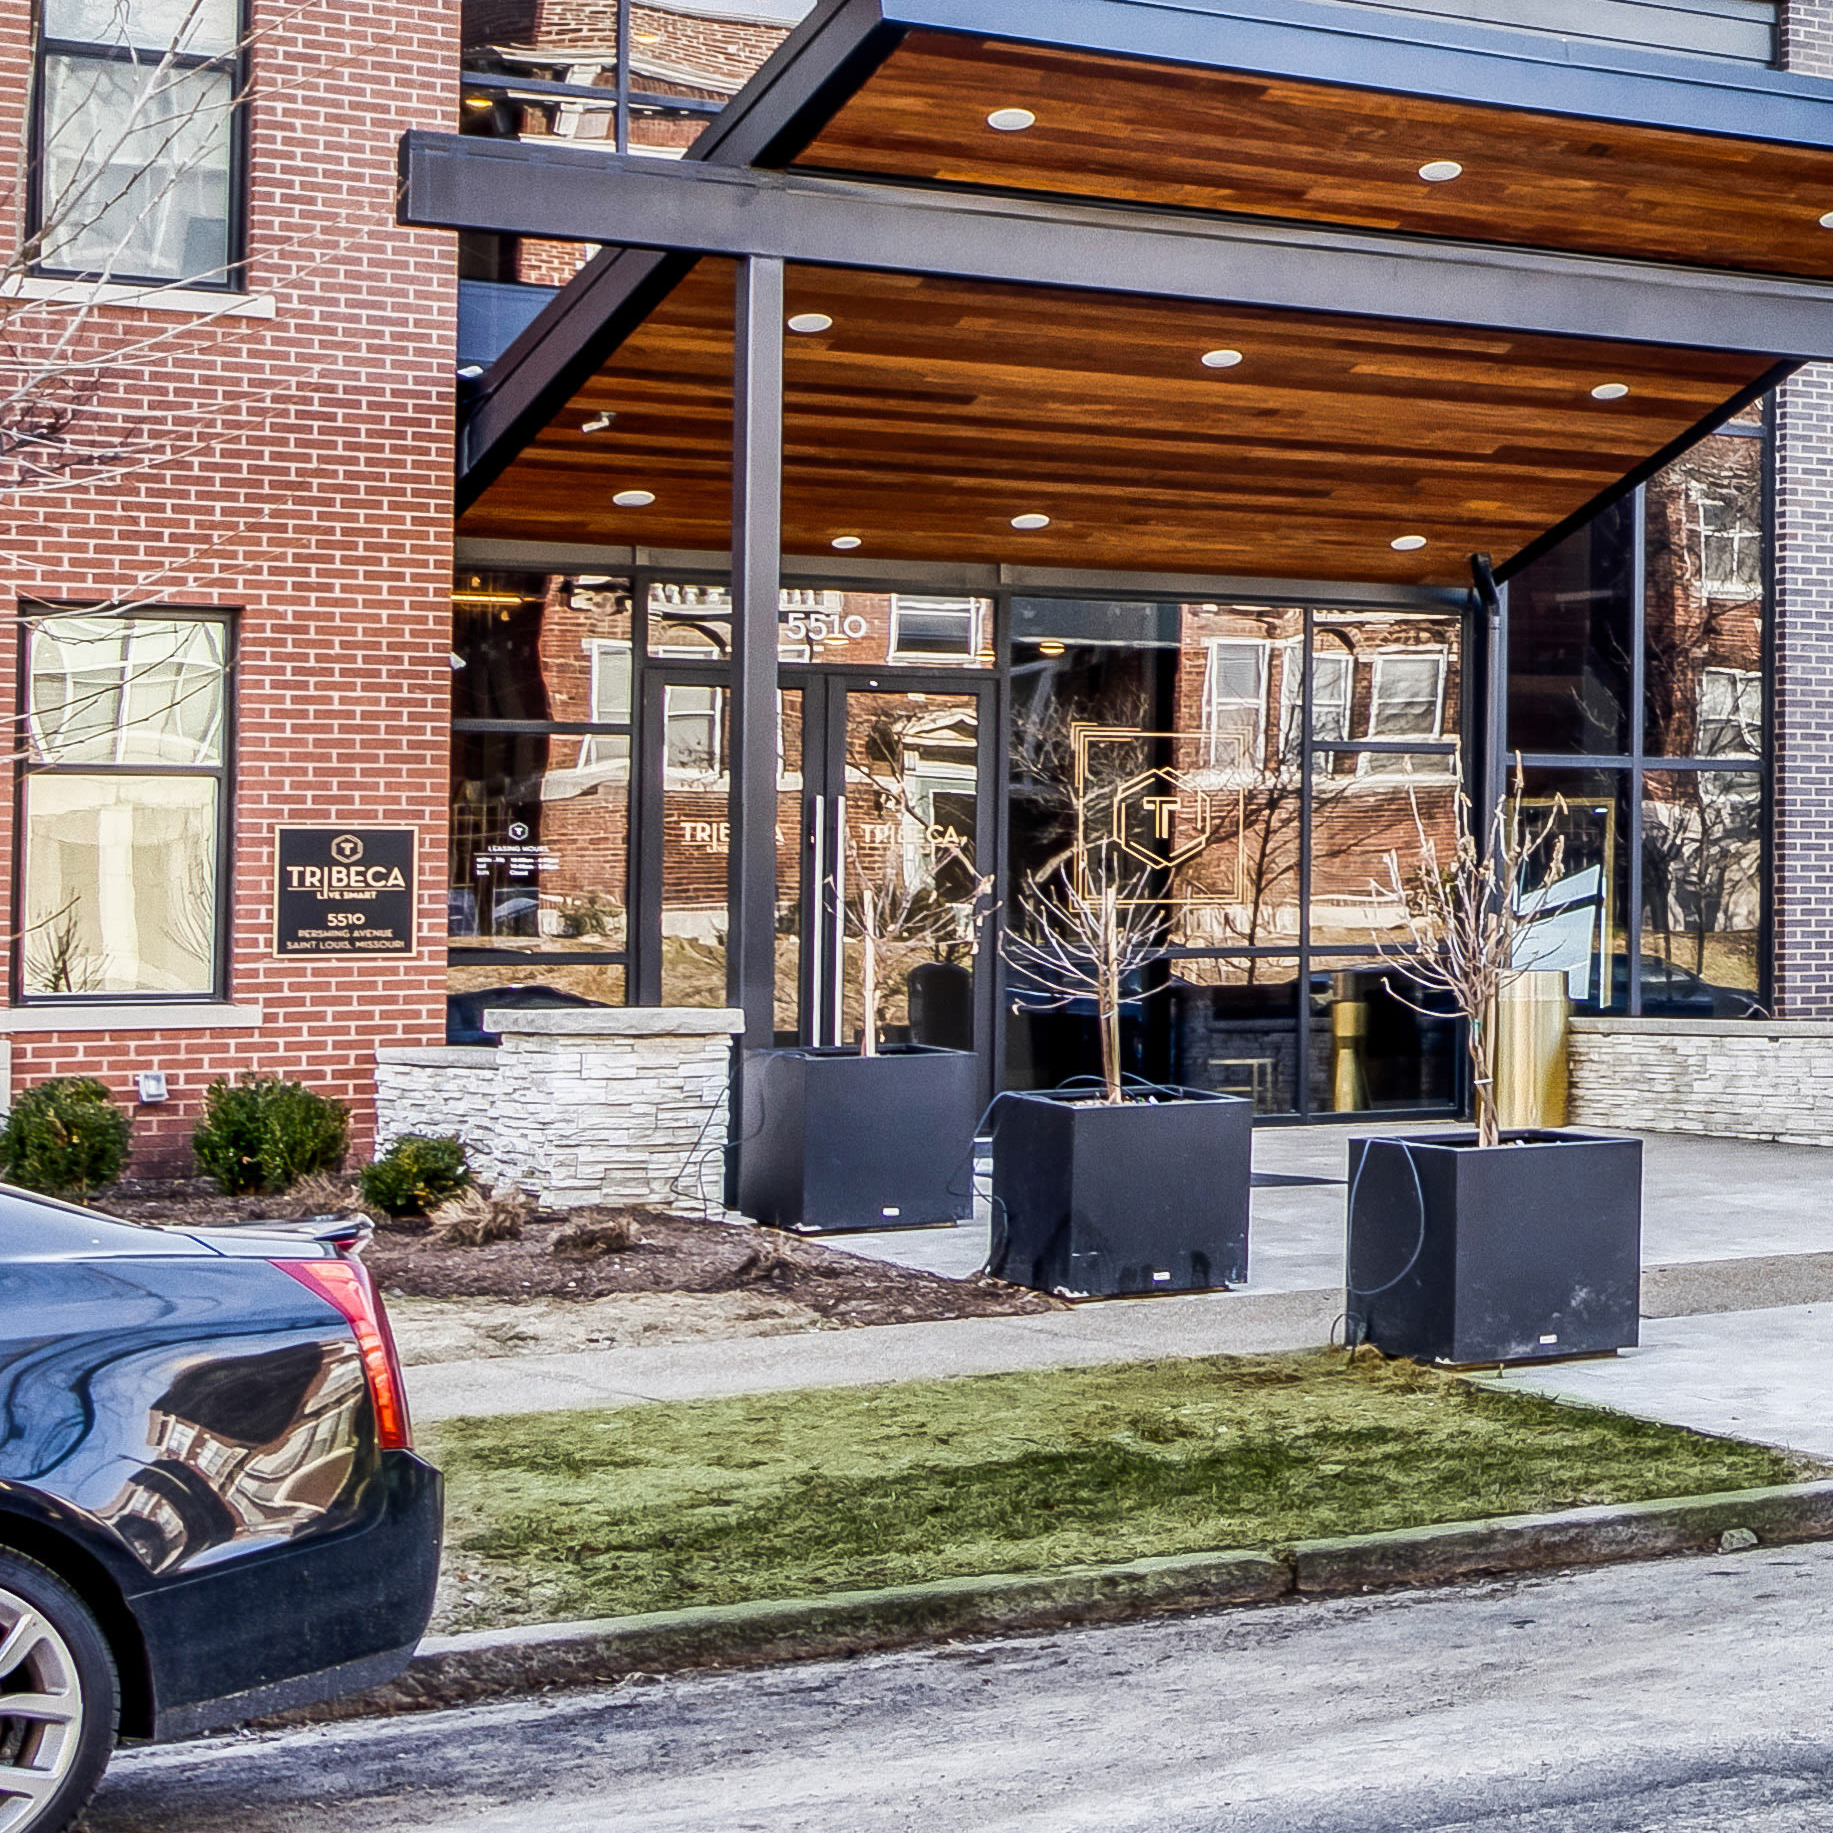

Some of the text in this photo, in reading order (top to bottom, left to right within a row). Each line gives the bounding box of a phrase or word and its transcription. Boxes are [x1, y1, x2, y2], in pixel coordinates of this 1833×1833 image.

[785, 612, 867, 640] 5510
[286, 866, 406, 890] TRIBECA
[316, 891, 378, 899] LIVE SMART
[327, 913, 366, 927] 5510
[298, 929, 393, 938] PERSHING AVENUE
[286, 941, 317, 950] SAINT
[355, 940, 405, 949] MISSOURI
